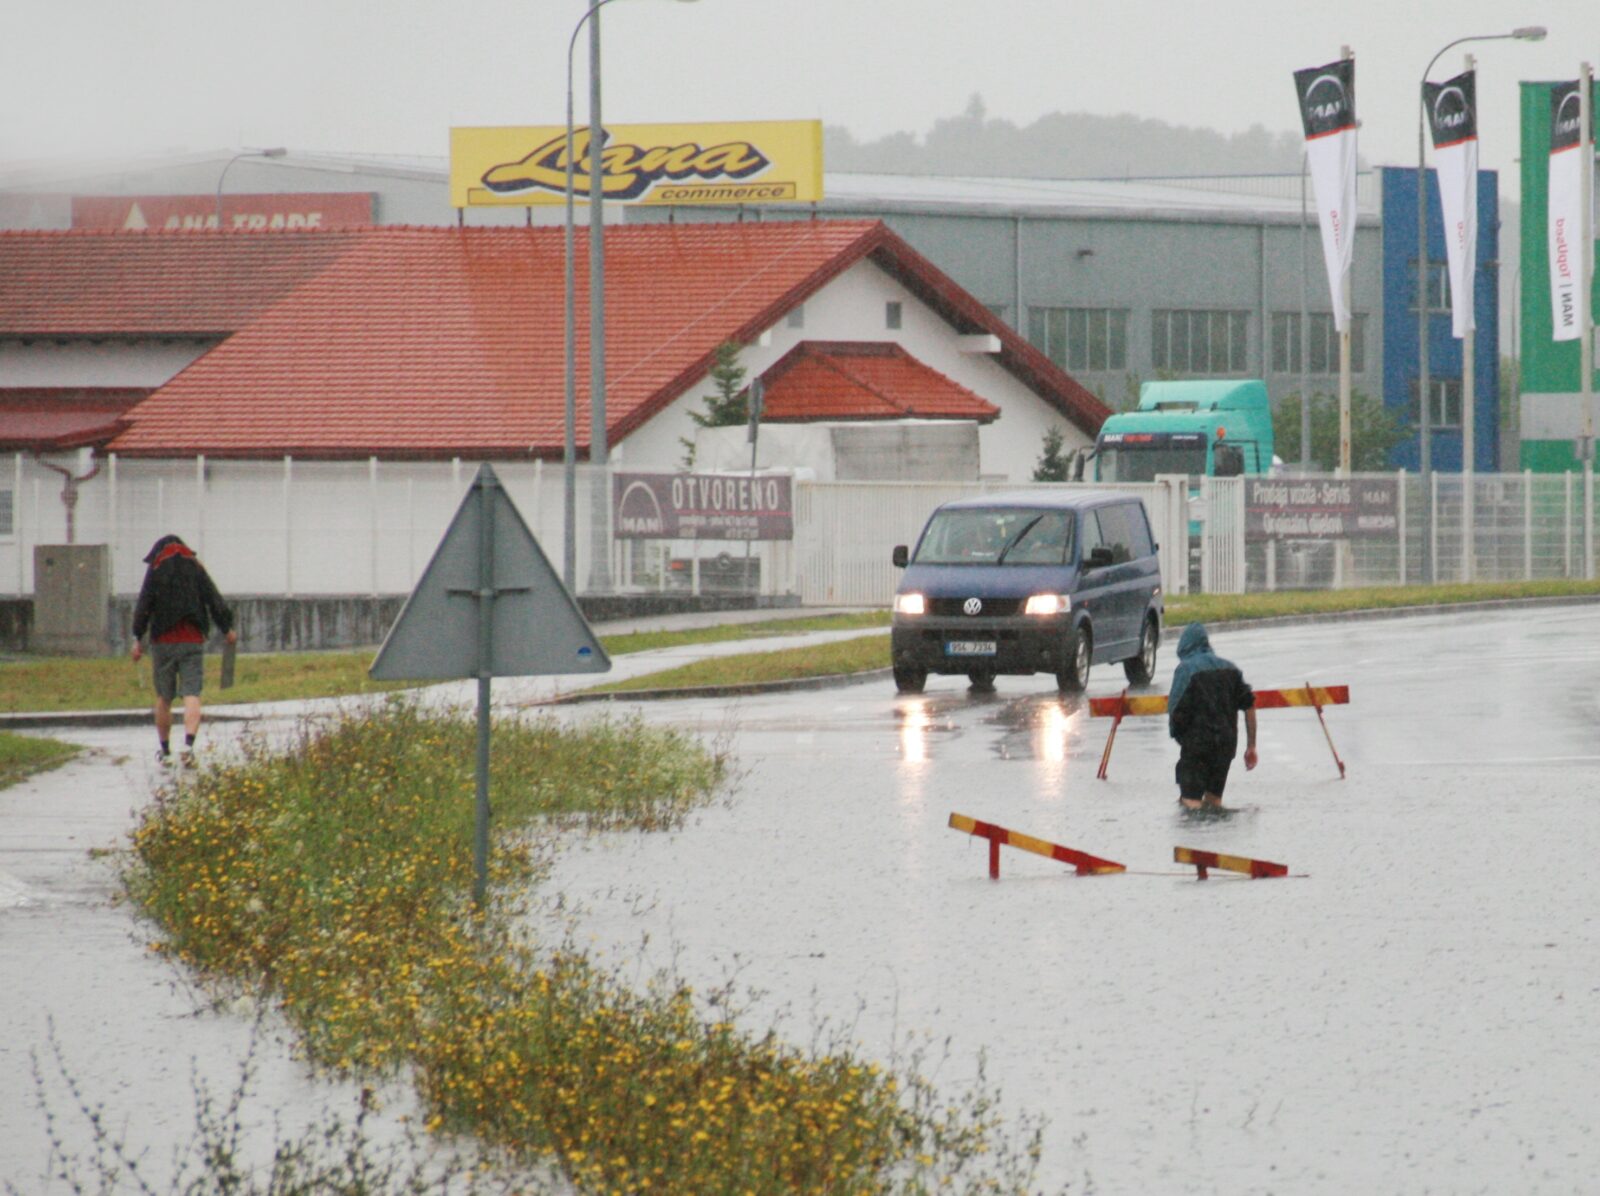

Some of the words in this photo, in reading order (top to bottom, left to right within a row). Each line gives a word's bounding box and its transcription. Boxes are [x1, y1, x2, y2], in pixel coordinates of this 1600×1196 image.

[481, 126, 771, 200] Lana
[660, 184, 785, 201] commerce
[232, 212, 323, 229] TRADE
[672, 477, 778, 511] OTVORENO
[1253, 482, 1288, 508] Prodaja
[1290, 482, 1317, 504] vozila
[1322, 482, 1351, 504] Servis
[622, 516, 660, 534] MAN
